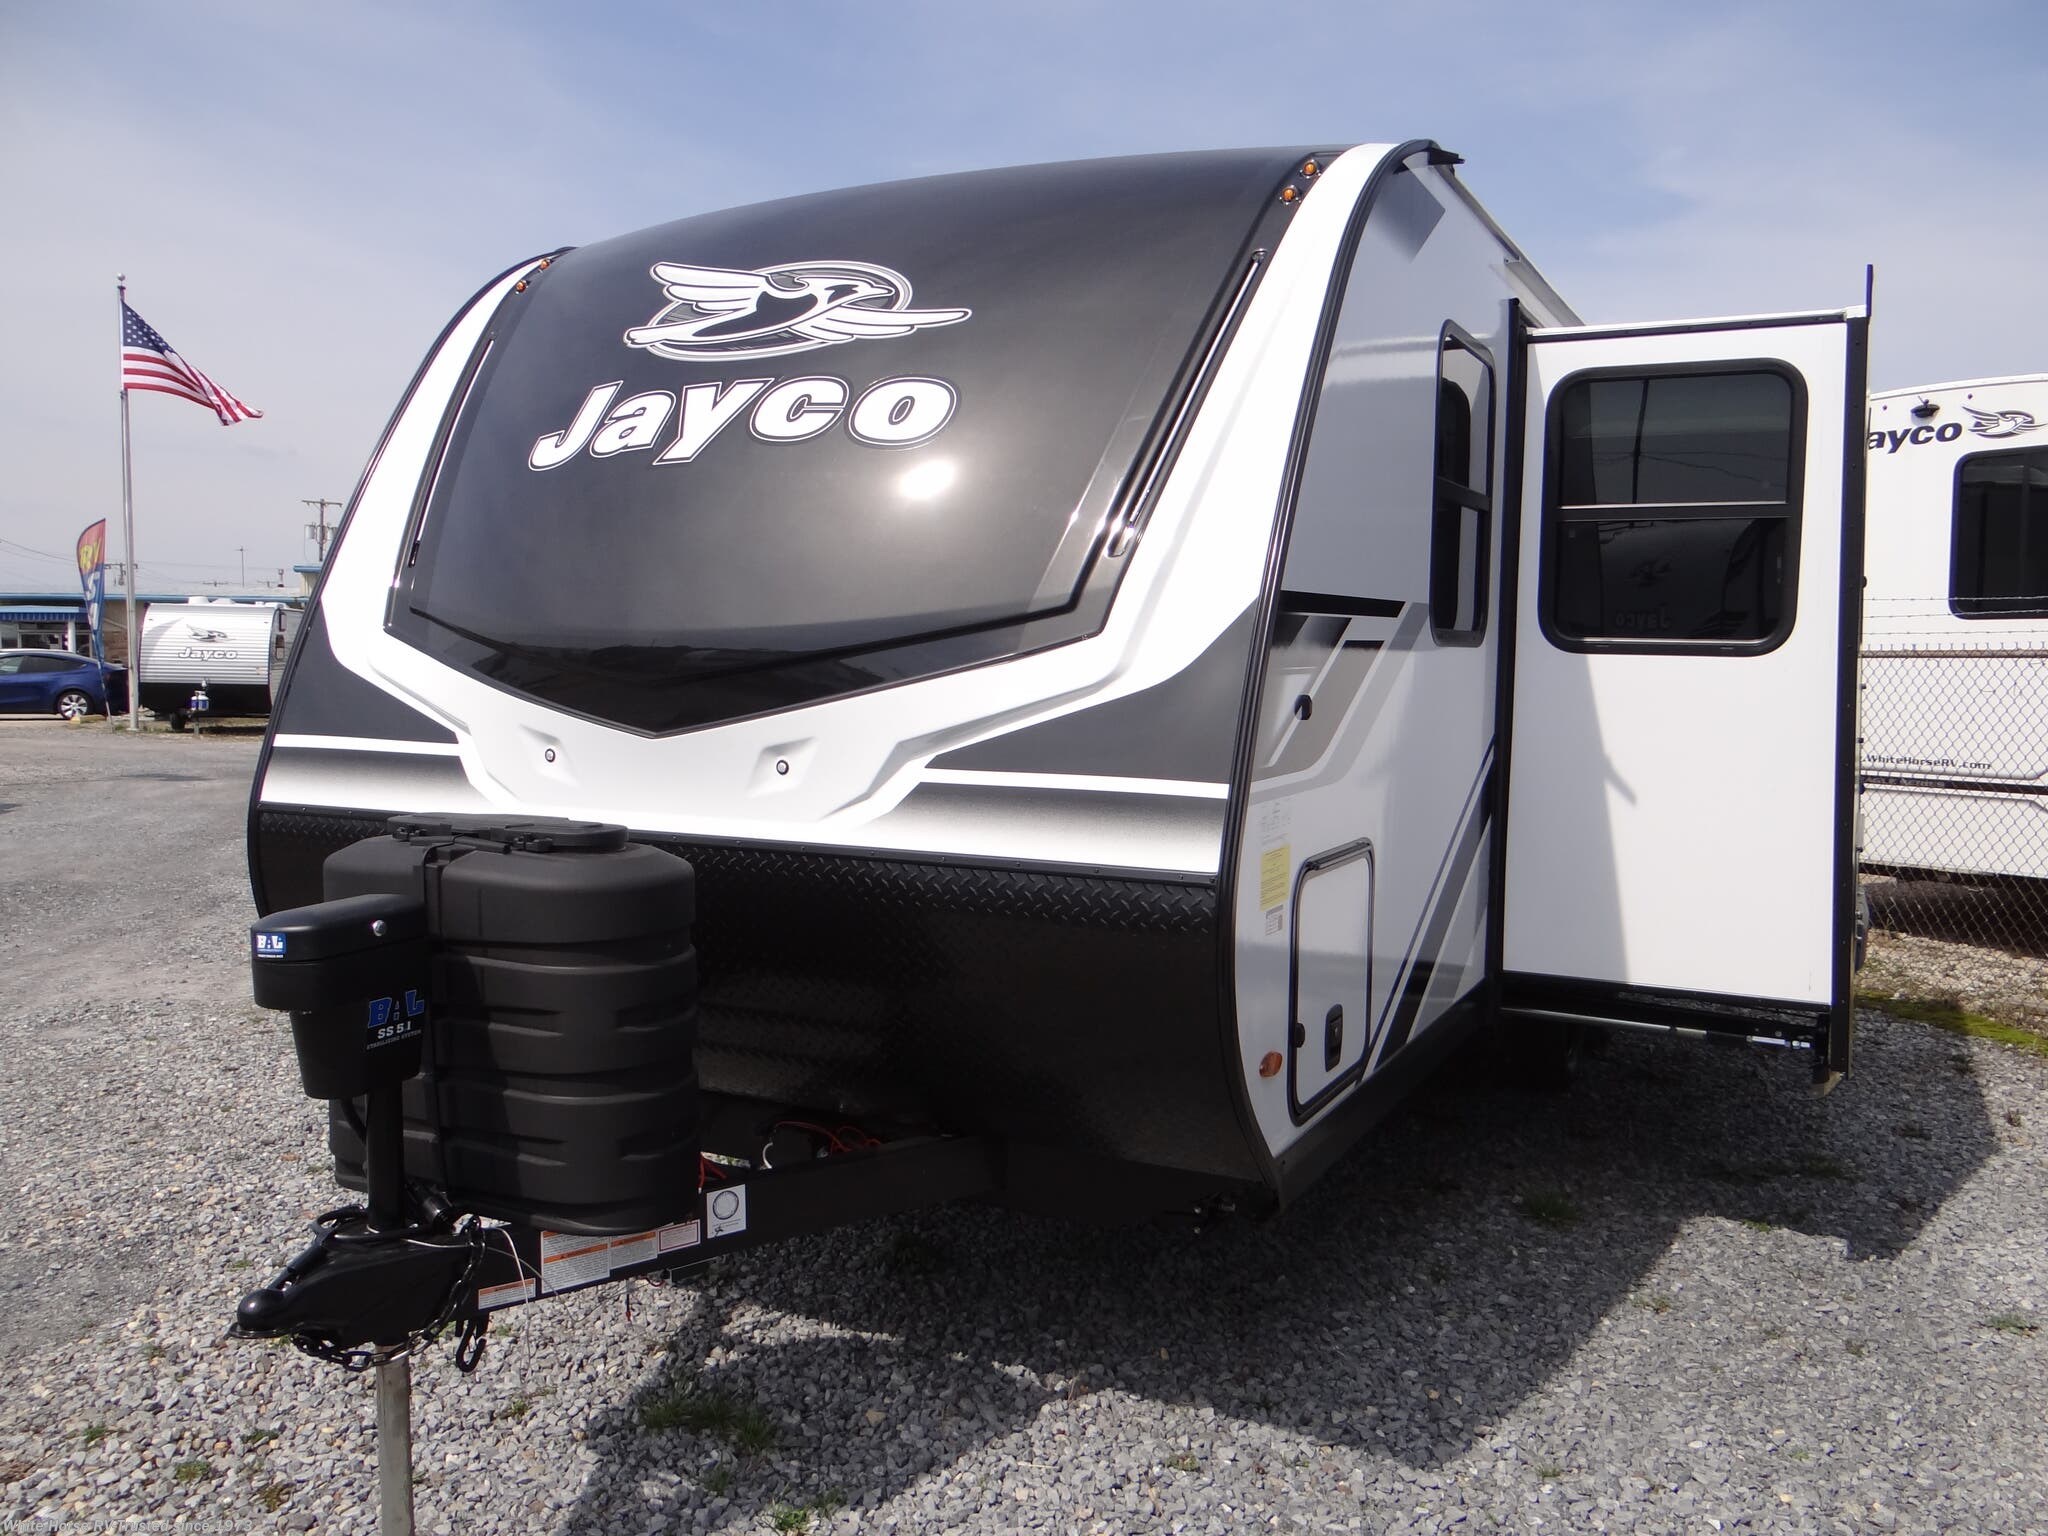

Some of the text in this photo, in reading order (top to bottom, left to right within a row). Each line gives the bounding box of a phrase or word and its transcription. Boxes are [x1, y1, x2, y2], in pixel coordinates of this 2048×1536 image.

[528, 375, 958, 471] Jayco
[1866, 423, 1962, 454] ayco
[178, 647, 239, 662] Jayco
[1860, 754, 1992, 770] .WhiteHorseRV.com
[256, 935, 284, 948] BAL
[368, 989, 425, 1028] BAL
[377, 1026, 395, 1040] SS
